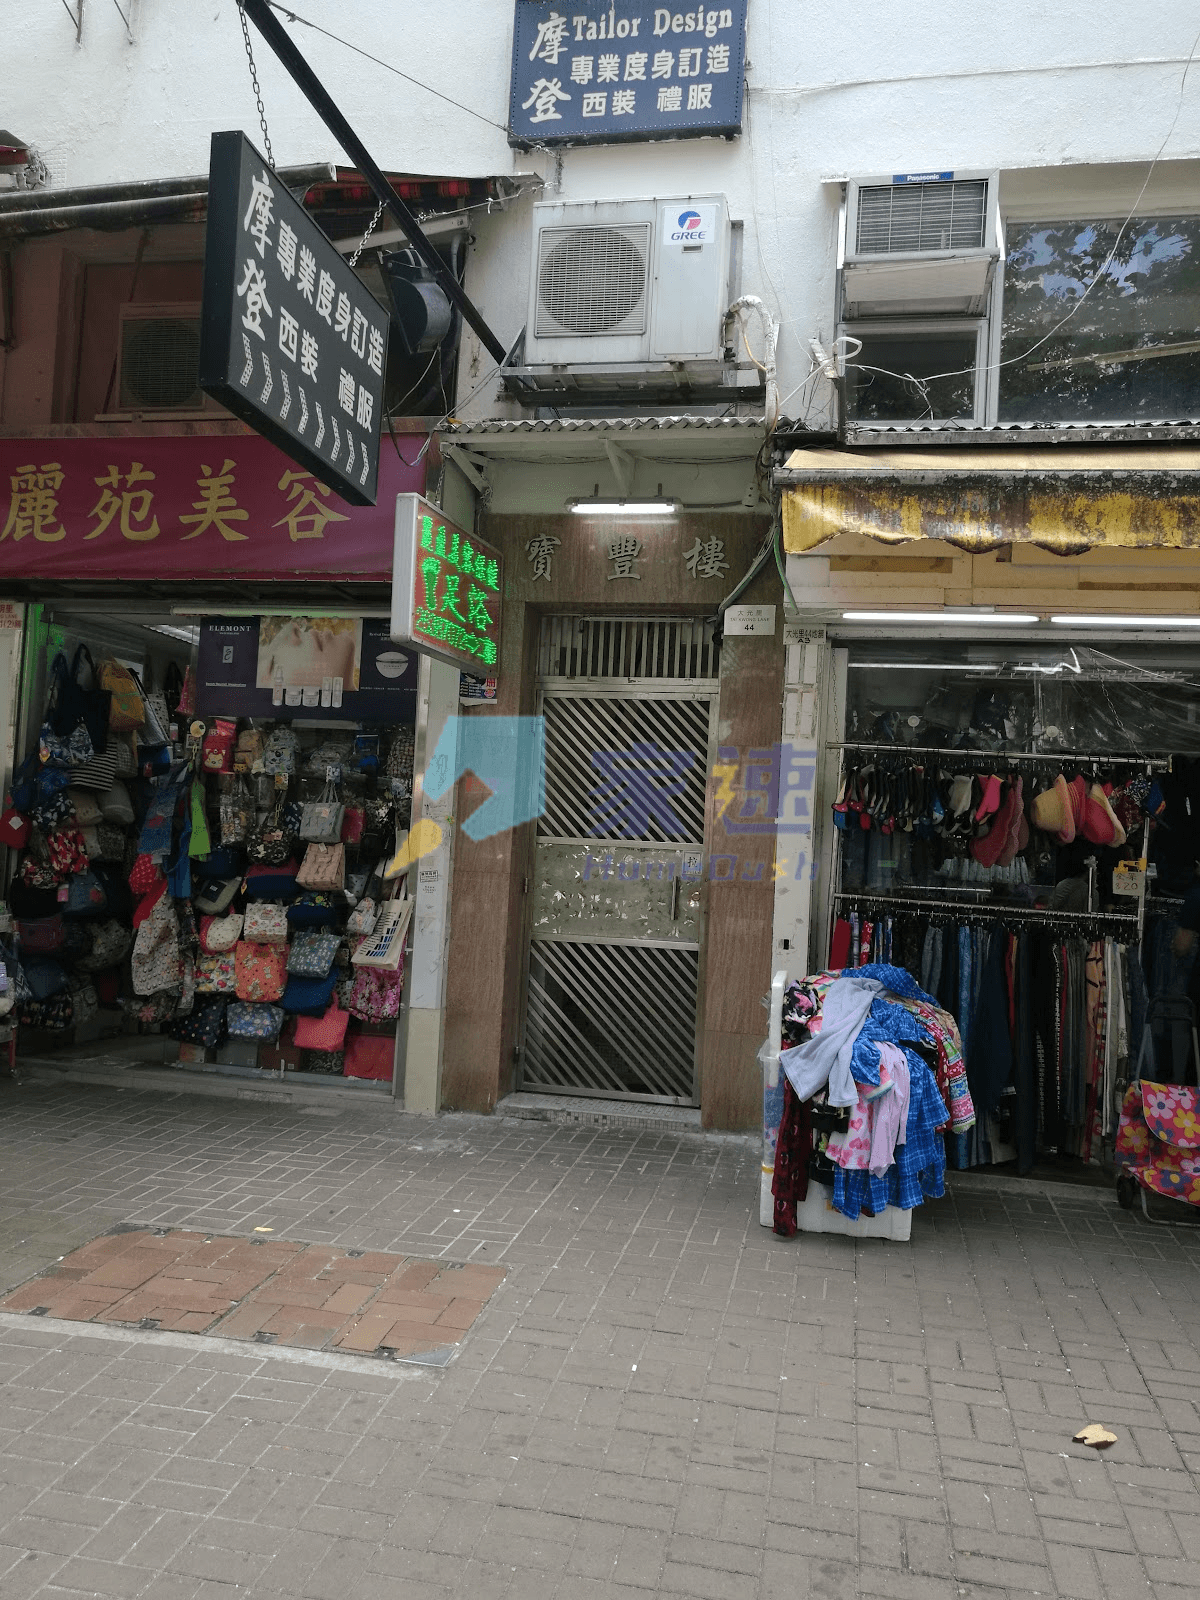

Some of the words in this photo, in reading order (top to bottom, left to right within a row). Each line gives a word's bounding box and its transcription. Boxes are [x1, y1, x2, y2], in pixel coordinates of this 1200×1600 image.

[572, 10, 642, 41] Tailor
[653, 6, 733, 38] Design
[521, 12, 572, 124] 摩登
[570, 44, 730, 85] 專業度身訂造
[582, 89, 636, 118] 西裝
[657, 83, 713, 112] 禮服
[907, 174, 940, 182] Panasonic
[237, 169, 275, 341] 摩登
[671, 231, 707, 241] GREE
[276, 219, 383, 377] 專業度身訂造
[278, 306, 319, 383] 西裝
[338, 366, 373, 433] 禮服
[0, 458, 352, 543] 麗苑美容
[524, 533, 730, 582] 寶豐樓
